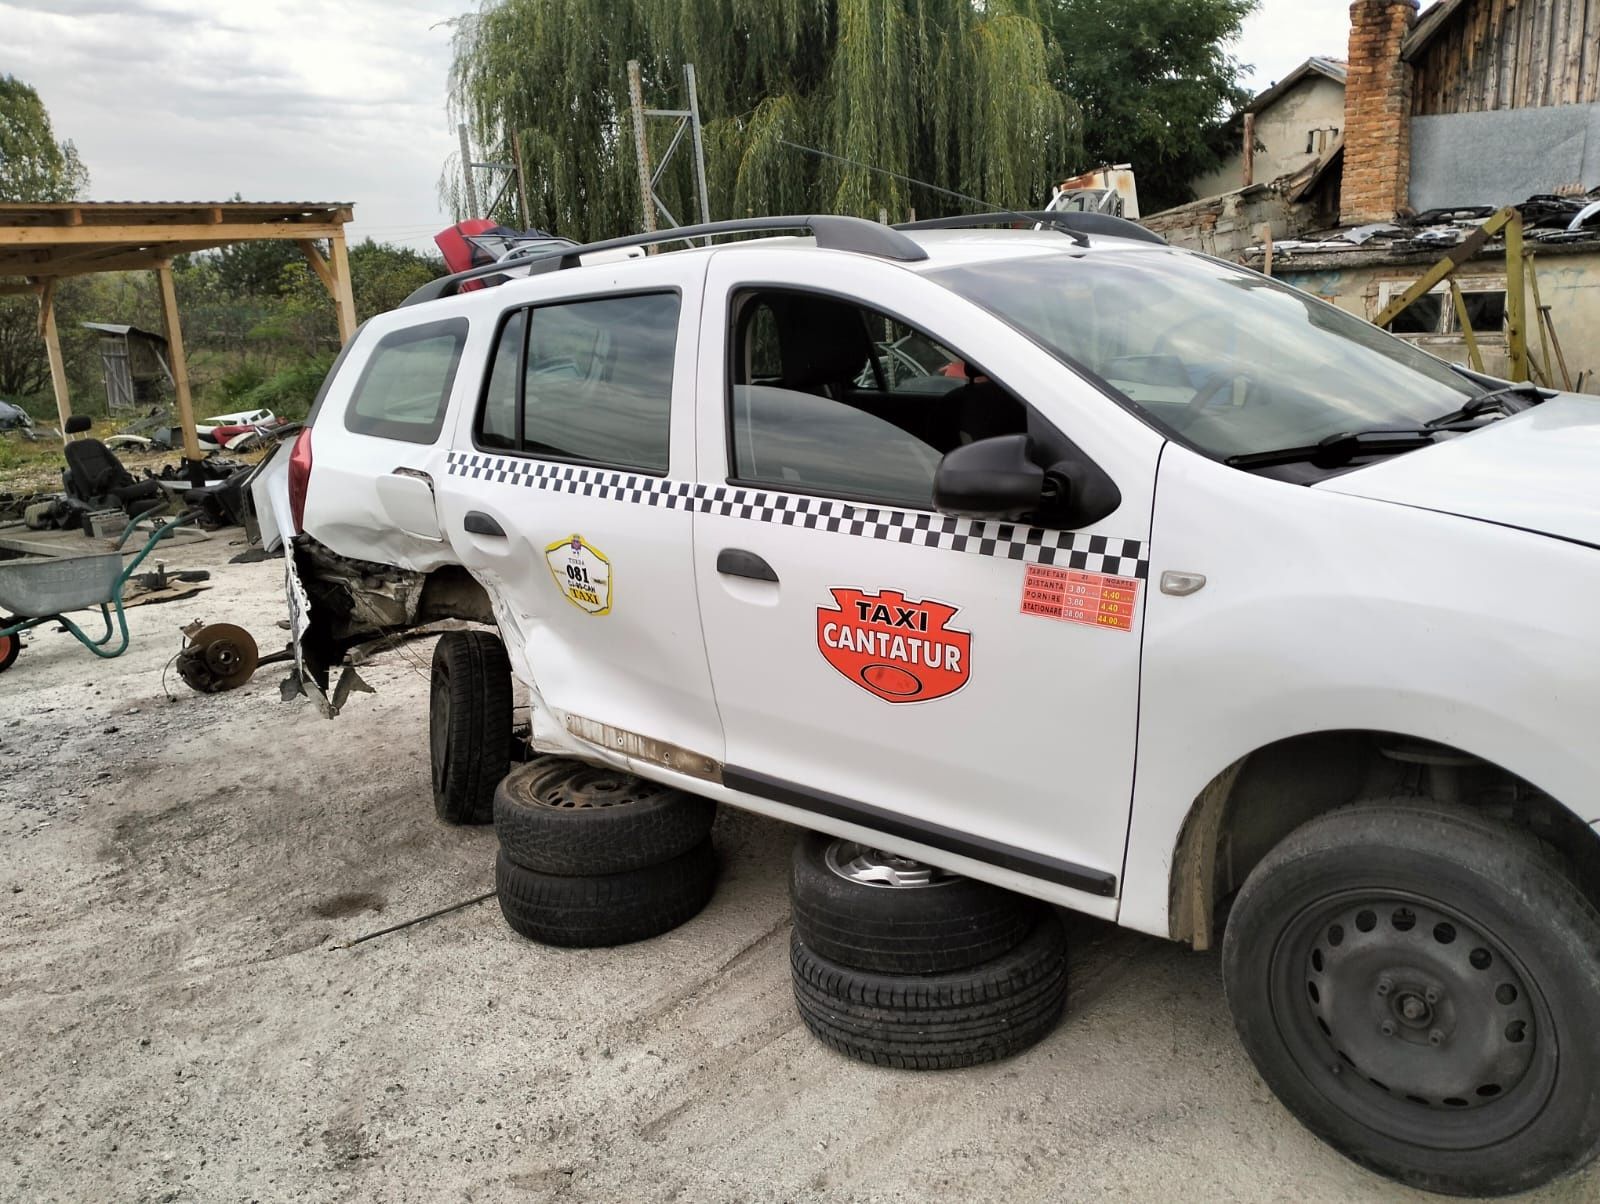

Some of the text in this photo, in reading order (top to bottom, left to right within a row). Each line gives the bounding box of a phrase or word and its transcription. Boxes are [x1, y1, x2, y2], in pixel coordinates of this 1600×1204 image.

[566, 564, 589, 583] 081
[1028, 567, 1051, 577] TARIFE
[1052, 570, 1067, 579] TAXI
[570, 588, 599, 604] TAXI
[1026, 590, 1061, 603] PORNIRE
[1027, 578, 1064, 590] DISTANTA
[1102, 590, 1120, 601] 4,40
[856, 601, 929, 632] TAXI
[1022, 602, 1063, 616] STATIONARE
[823, 622, 963, 673] CANTATUR
